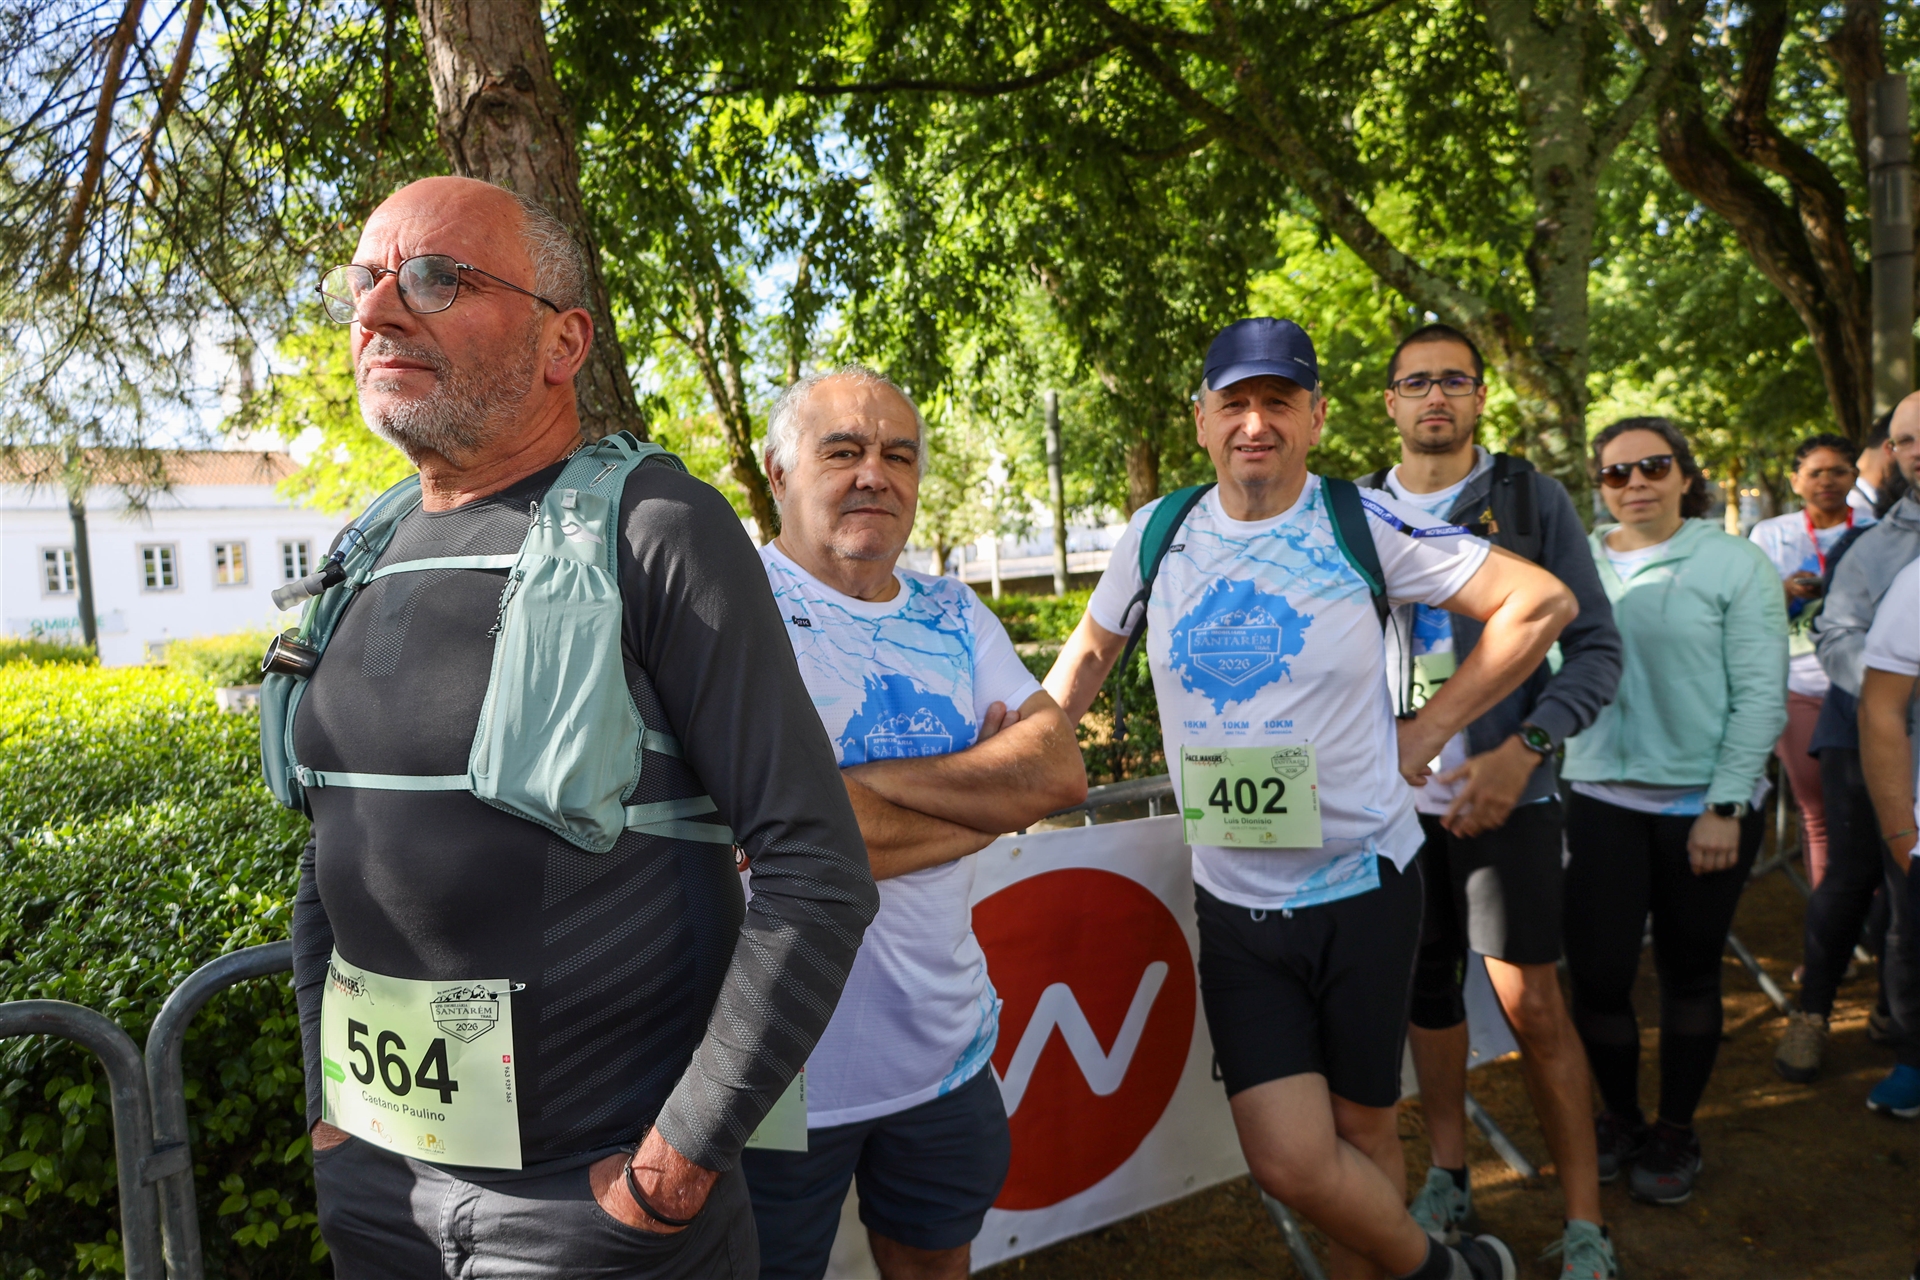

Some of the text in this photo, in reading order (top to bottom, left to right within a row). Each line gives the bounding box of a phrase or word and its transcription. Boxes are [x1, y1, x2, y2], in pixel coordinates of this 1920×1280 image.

[1194, 633, 1271, 646] SANTARÉM
[1218, 658, 1251, 670] 2026
[1183, 720, 1207, 729] 18KM
[1222, 720, 1249, 729] 10KM
[1264, 719, 1293, 729] 10KM
[1208, 777, 1288, 814] 402
[435, 1005, 493, 1016] SANTARÉM
[456, 1022, 479, 1032] 2026
[348, 1017, 459, 1105] 564
[361, 1090, 400, 1113] Caetano
[401, 1103, 446, 1122] Paulino
